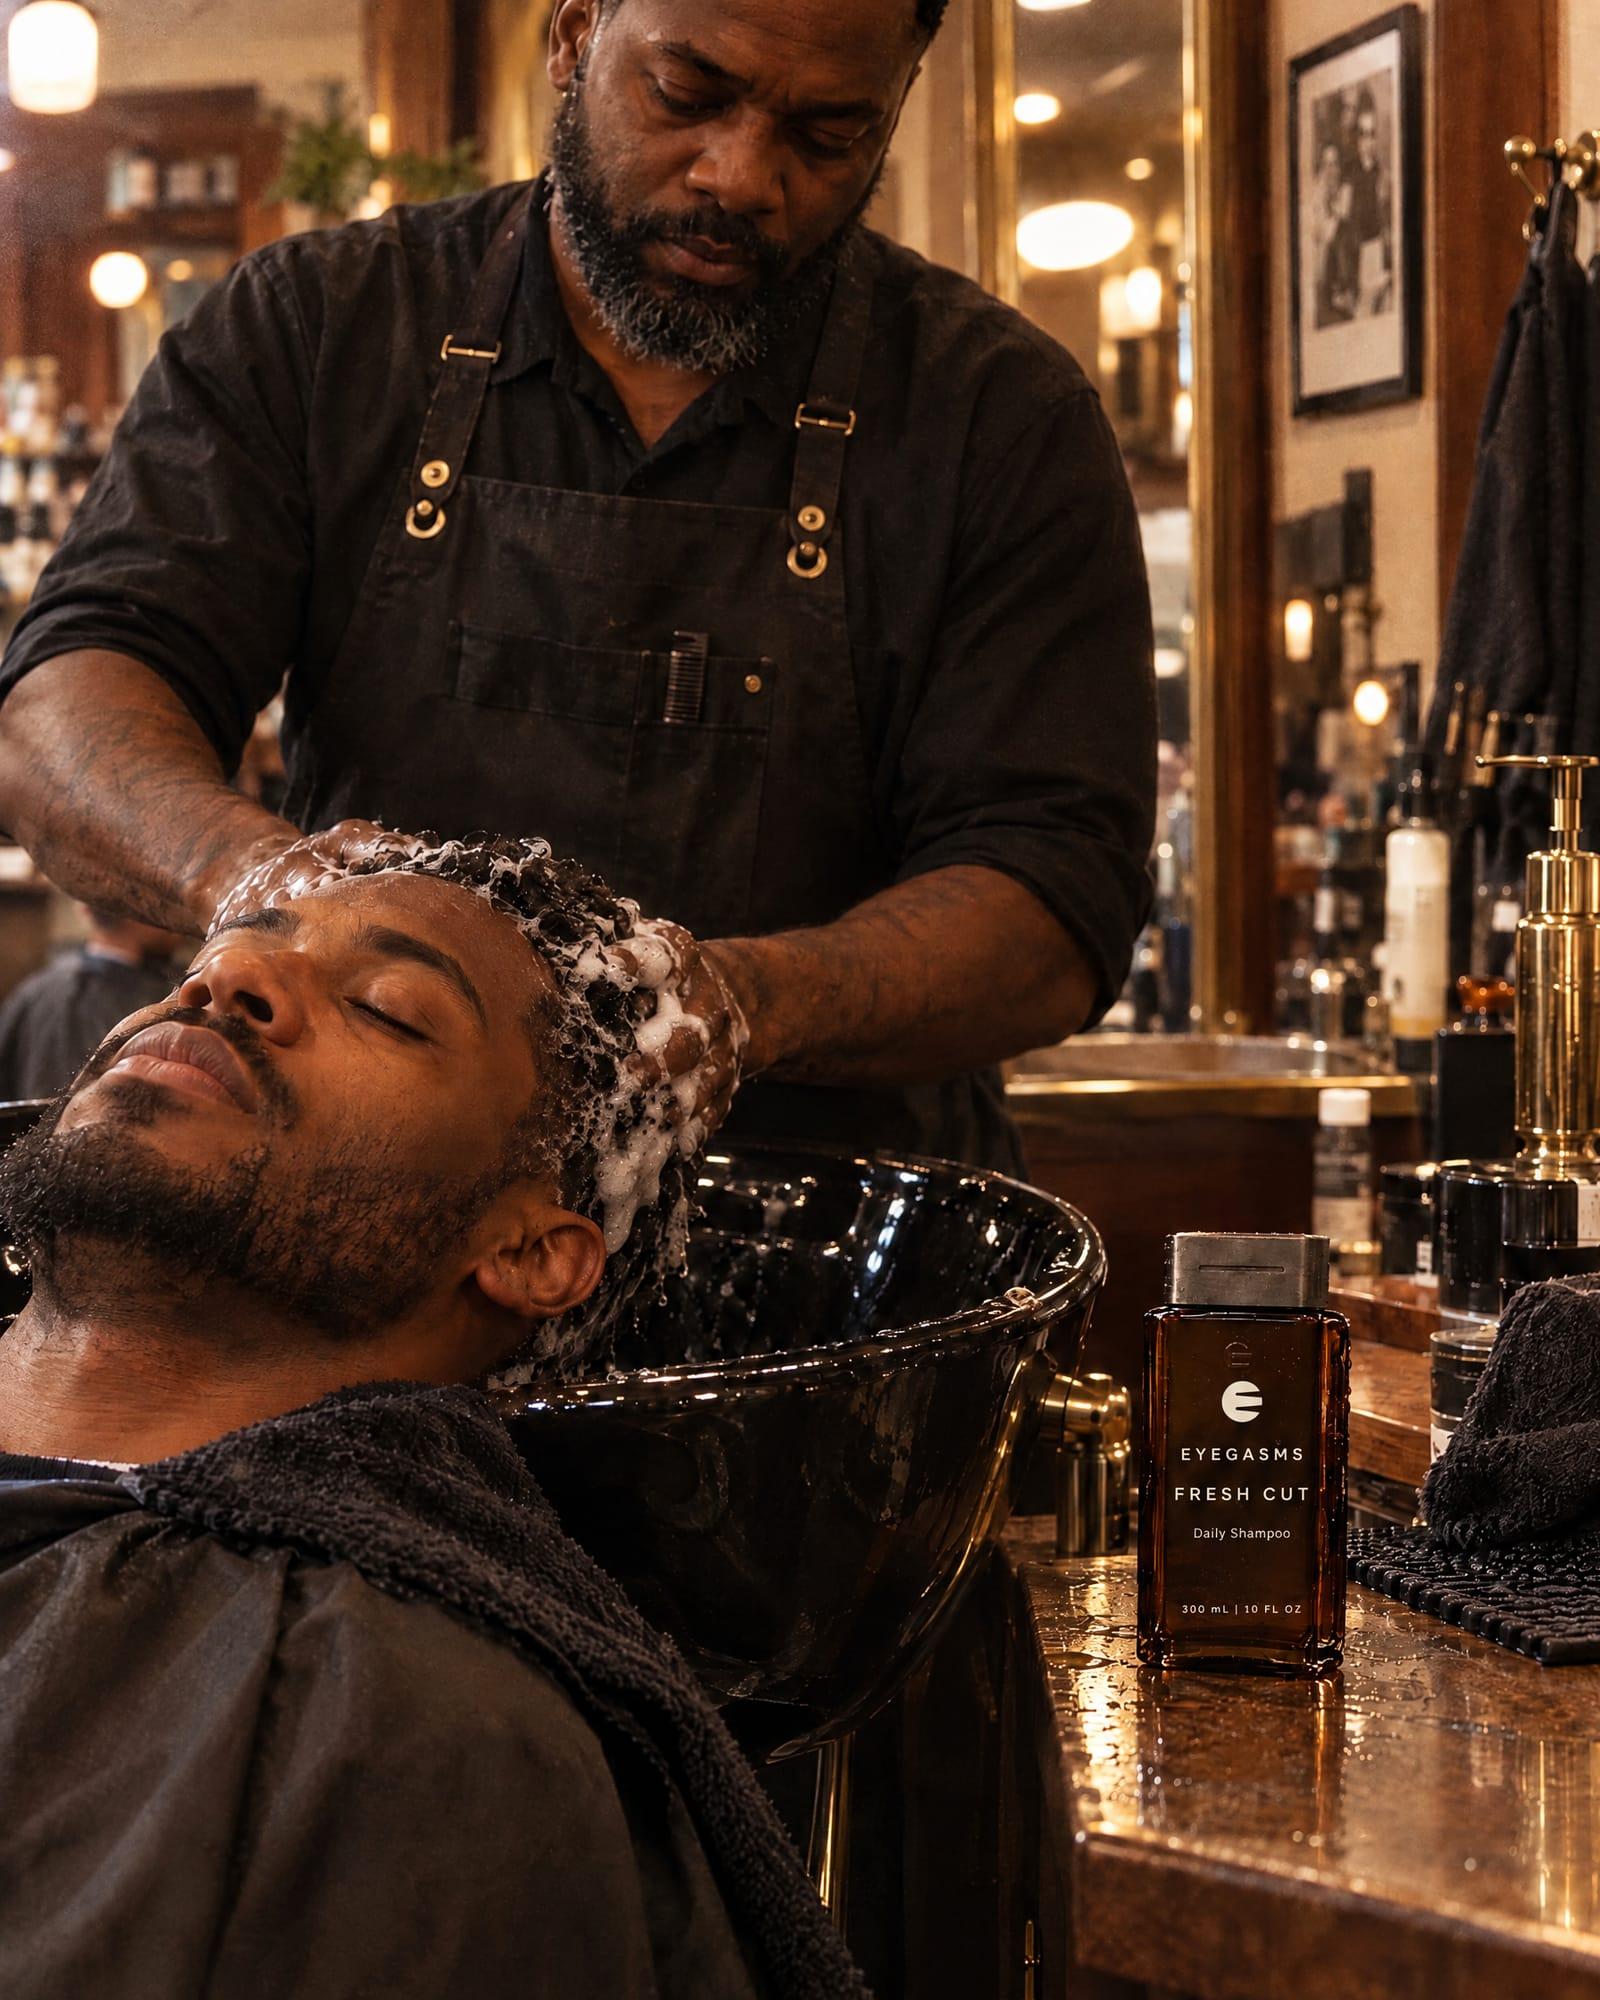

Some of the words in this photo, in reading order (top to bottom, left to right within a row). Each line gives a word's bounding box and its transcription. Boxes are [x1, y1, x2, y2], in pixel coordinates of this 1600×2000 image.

[1181, 1447, 1303, 1462] EYEGASMS
[1174, 1487, 1249, 1501] FRESH
[1262, 1487, 1309, 1501] CUT
[1193, 1527, 1226, 1541] Daily
[1230, 1527, 1291, 1541] Shampoo
[1182, 1604, 1205, 1614] 300
[1211, 1604, 1229, 1614] mL
[1244, 1604, 1258, 1614] 10
[1264, 1604, 1279, 1614] FL
[1284, 1604, 1301, 1614] OZ
